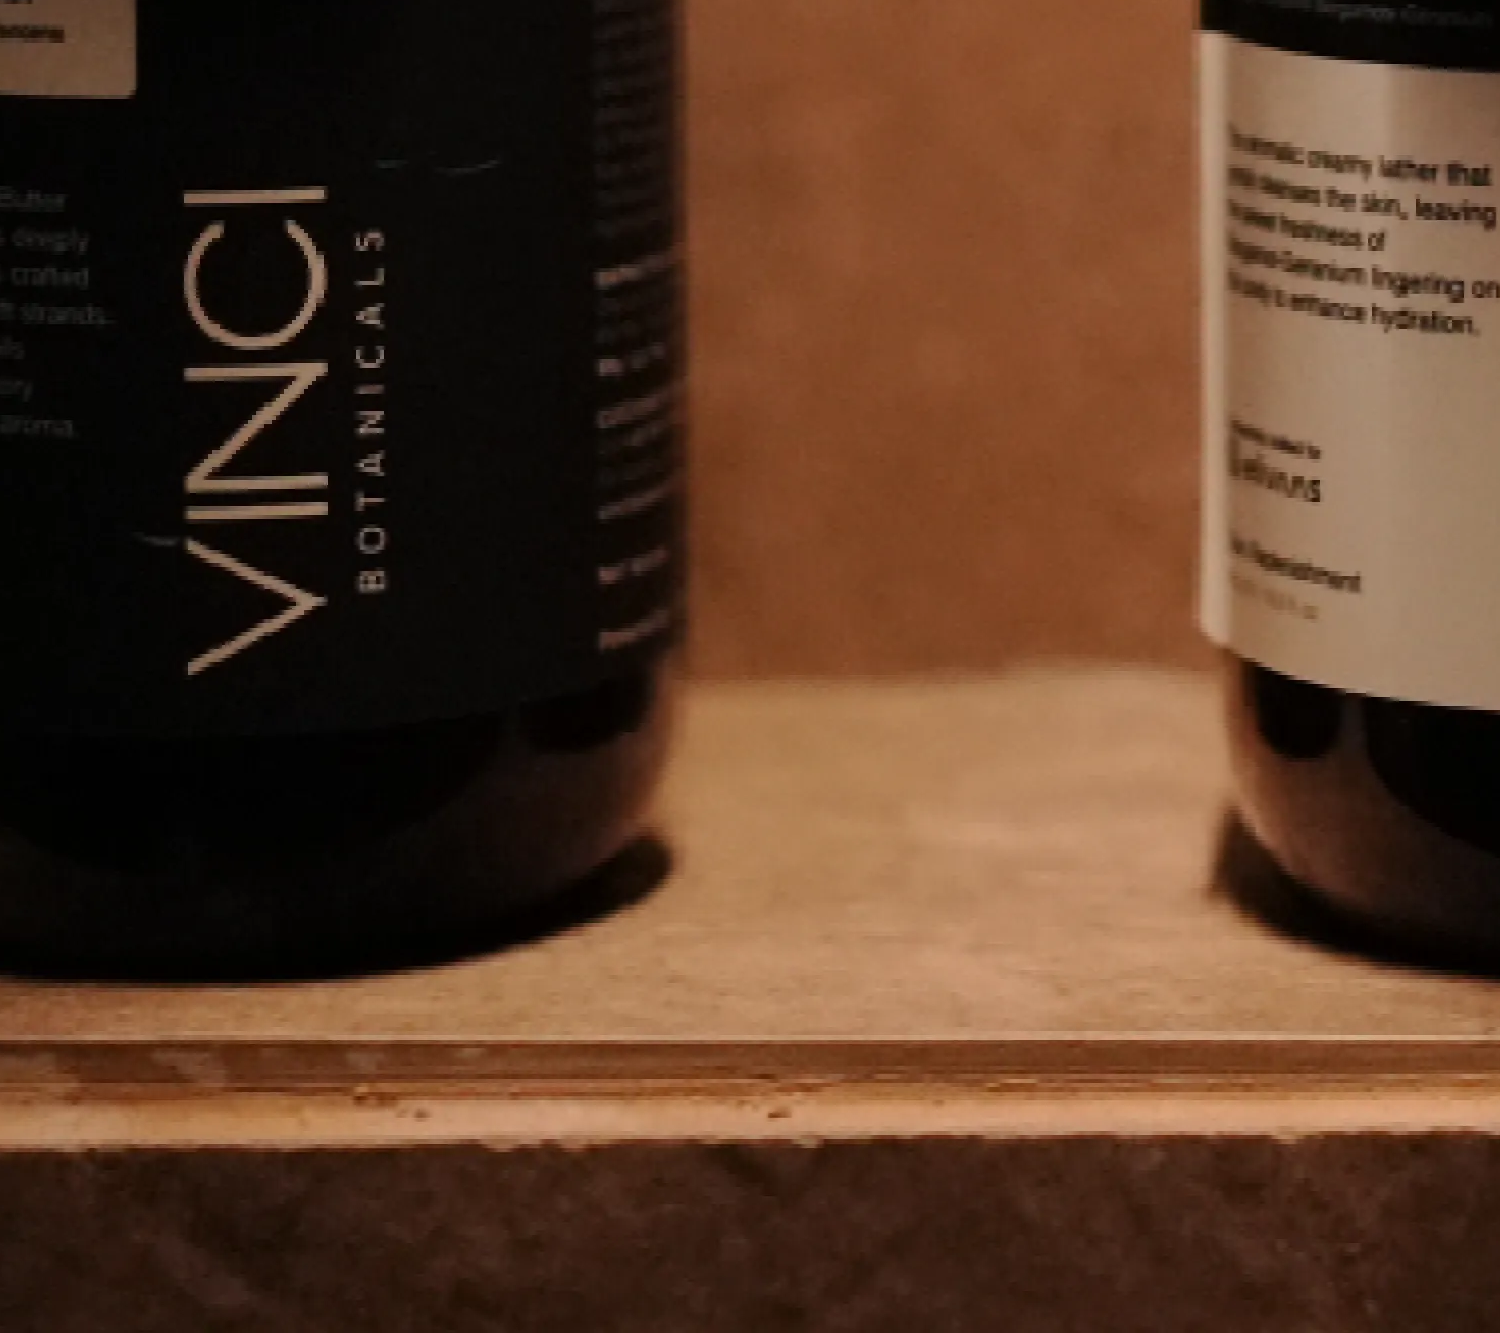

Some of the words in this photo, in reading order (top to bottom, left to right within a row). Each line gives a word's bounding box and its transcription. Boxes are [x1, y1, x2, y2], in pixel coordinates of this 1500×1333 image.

[1445, 162, 1492, 186] that
[1415, 196, 1497, 230] leaving
[1371, 265, 1465, 304] lingering
[1371, 304, 1481, 336] hydration.
[354, 228, 386, 594] BOTANICALS
[184, 185, 328, 675] VINCI
